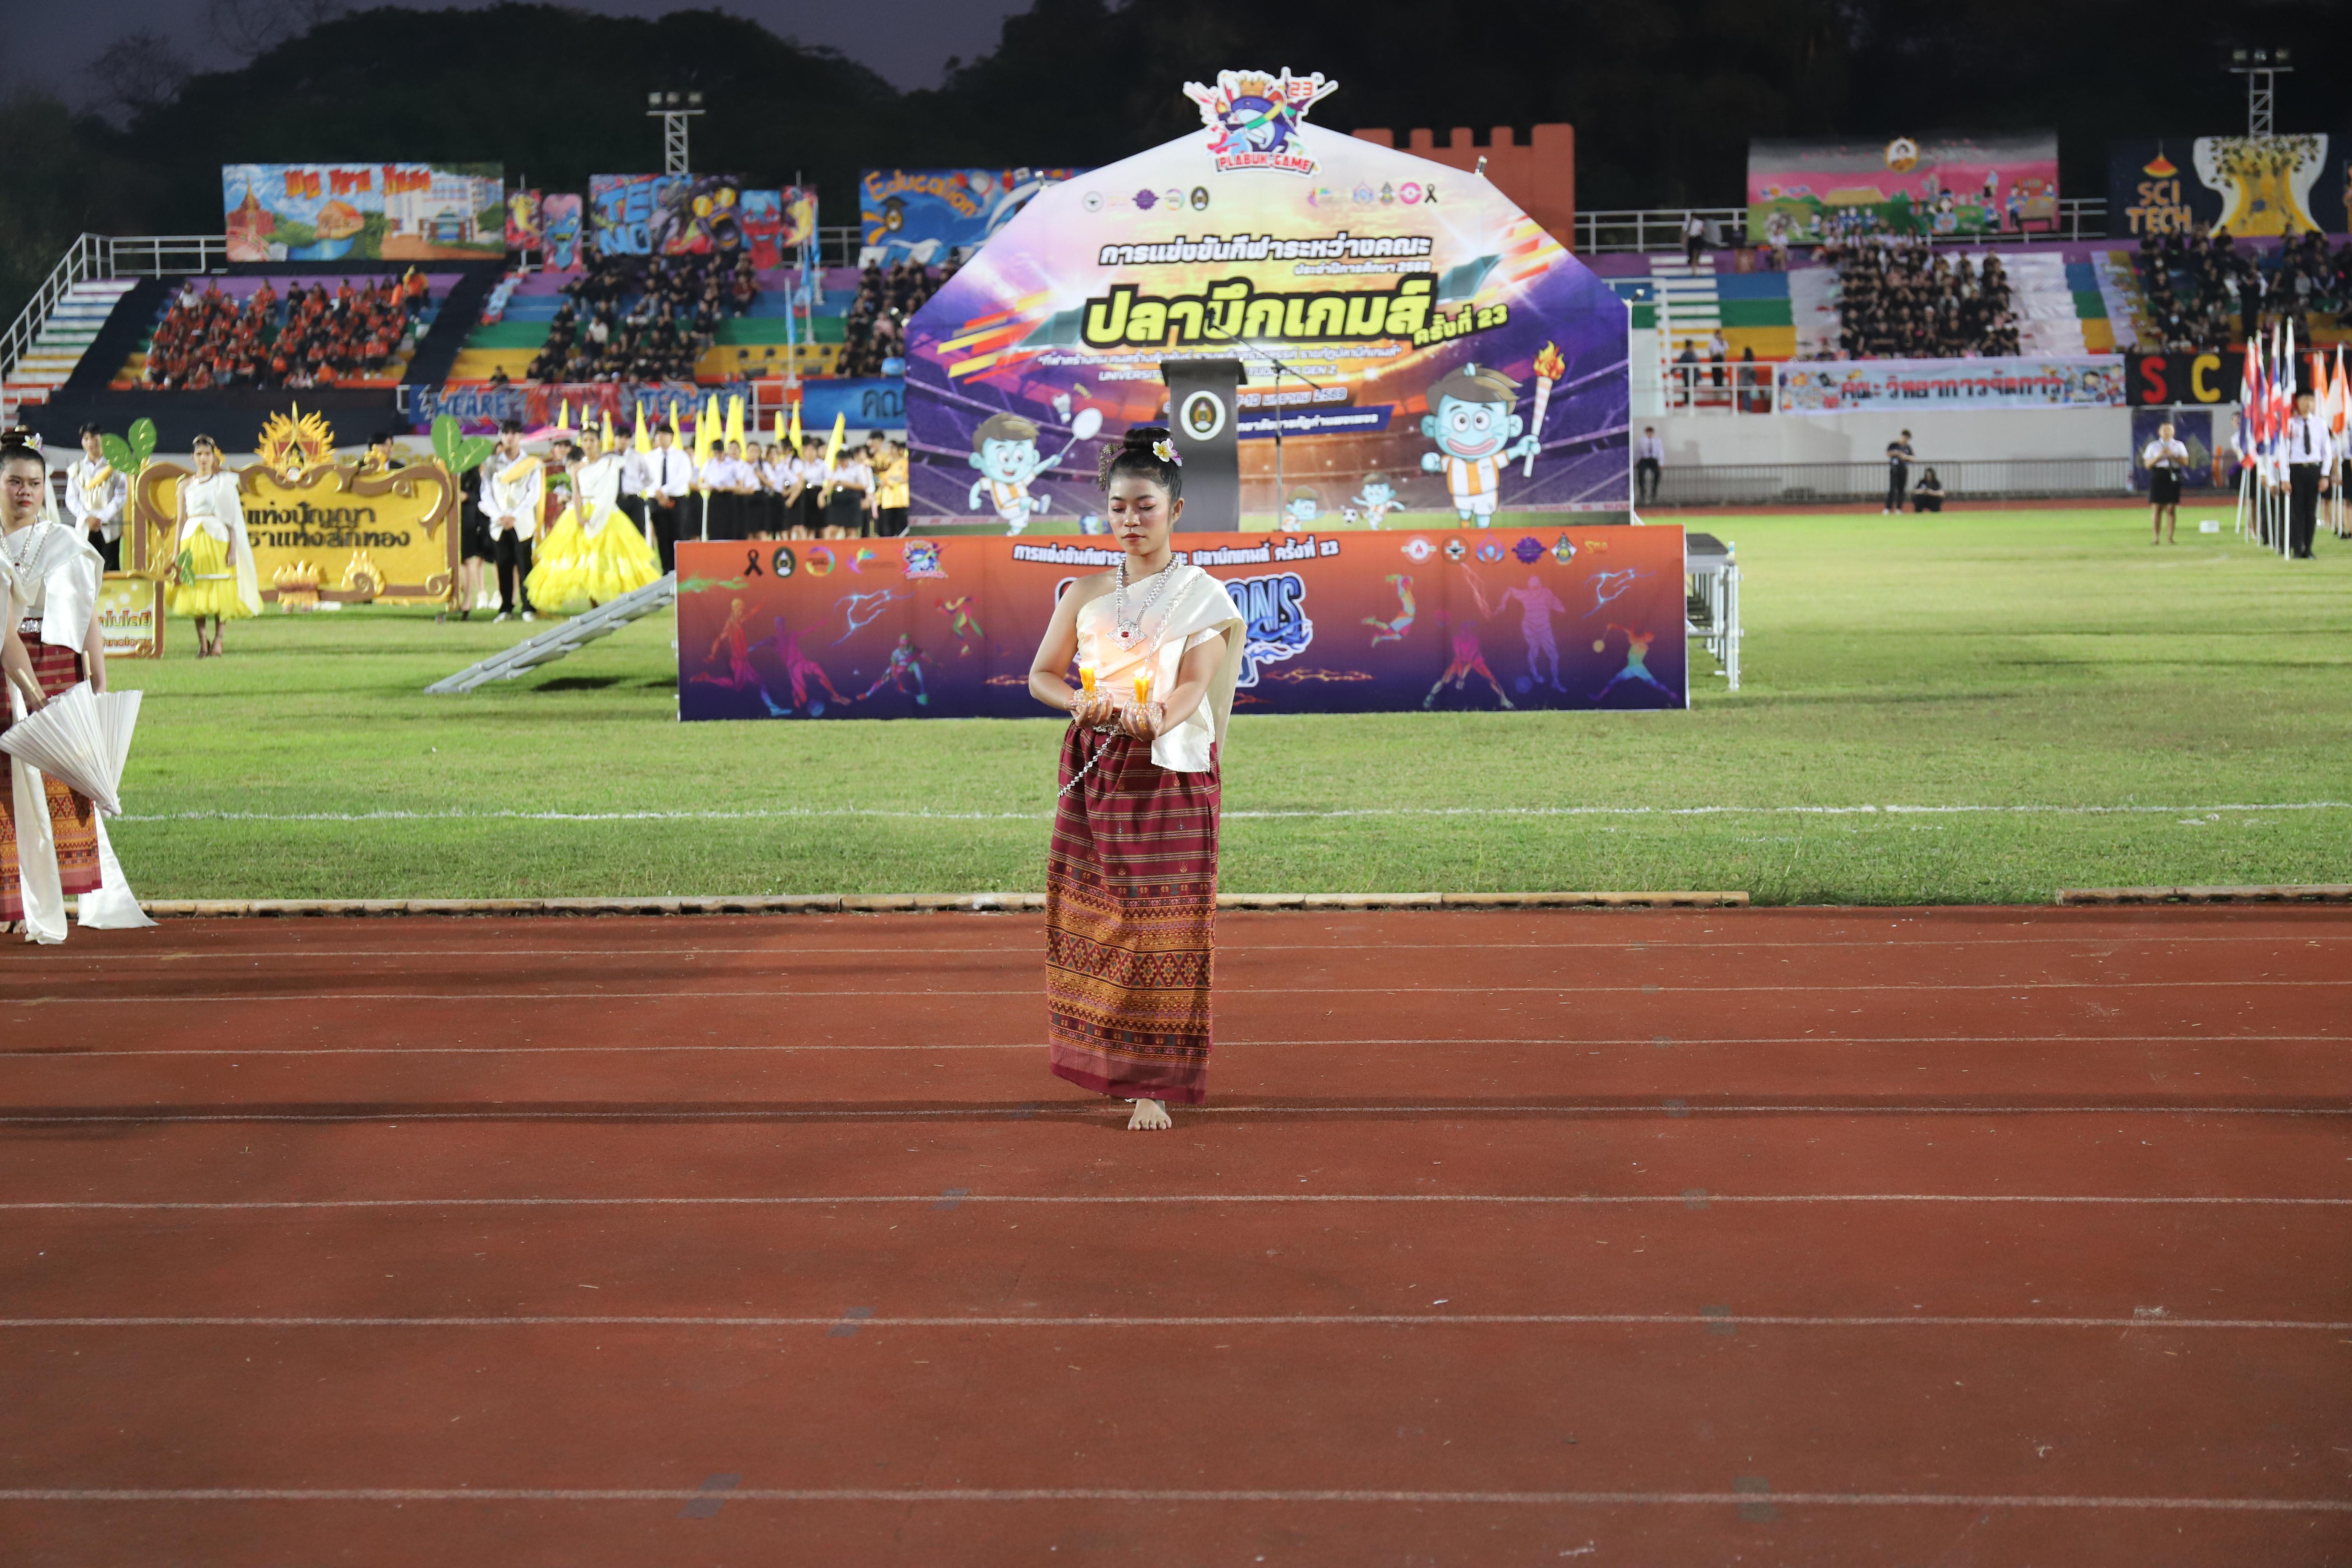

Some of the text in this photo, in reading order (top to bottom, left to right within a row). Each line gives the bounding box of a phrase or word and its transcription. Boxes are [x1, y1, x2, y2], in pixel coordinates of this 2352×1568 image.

[1290, 81, 1312, 96] 23
[1219, 153, 1310, 170] PLABUK GAME
[2137, 179, 2180, 206] SCI
[2125, 205, 2192, 235] TECH
[599, 222, 651, 256] NO
[1099, 231, 1432, 265] การแข่งขันกีฬาระหว่างคณะ
[1083, 277, 1508, 346] ปลาบึกเกมส์ ครั้งที่ 23
[1842, 368, 2064, 398] คณะ วิทยาการจัดการ
[2140, 356, 2167, 404] S
[2191, 354, 2221, 402] C
[1191, 542, 1271, 565] ปลาบึกเกมส์
[1274, 535, 1316, 561] ครั้งที่
[1320, 540, 1340, 557] 23
